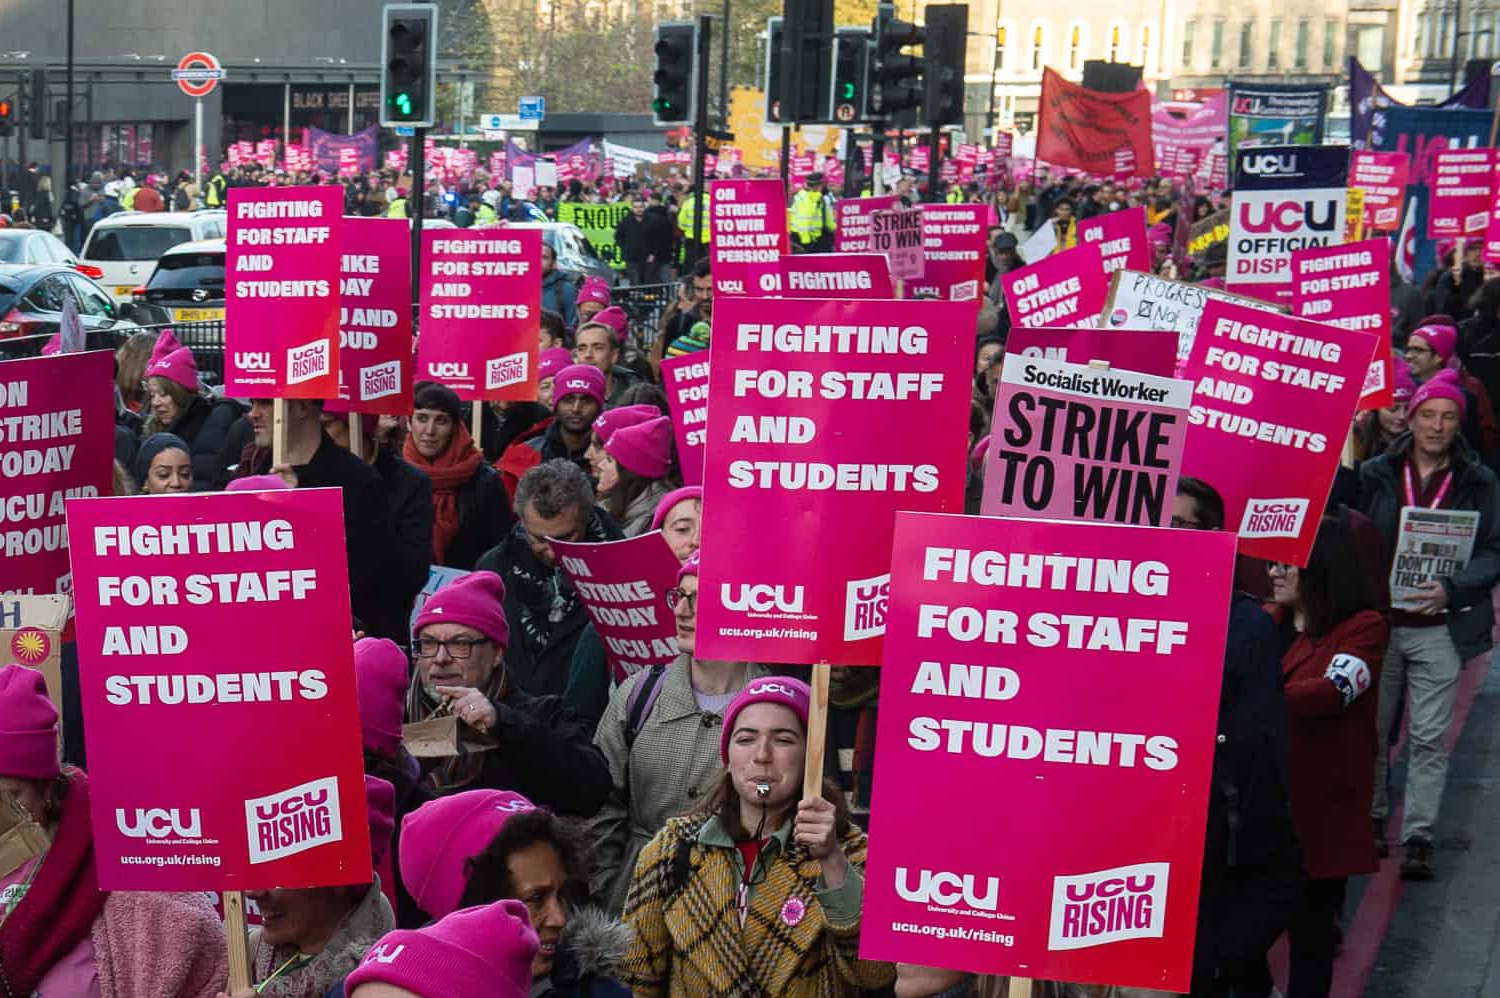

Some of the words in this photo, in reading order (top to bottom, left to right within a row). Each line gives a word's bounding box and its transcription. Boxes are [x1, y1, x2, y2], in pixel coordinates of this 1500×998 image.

[1242, 155, 1297, 174] UCU
[715, 188, 736, 201] ON
[237, 200, 323, 219] FIGHTING
[715, 203, 767, 217] STRIKE
[1239, 200, 1337, 233] UCU
[715, 219, 734, 232] TO
[735, 219, 765, 232] WIN
[873, 211, 921, 232] STRIKE
[236, 228, 273, 246] FOR
[273, 227, 330, 245] STAFF
[716, 234, 755, 248] BACK
[756, 234, 780, 246] MY
[873, 233, 892, 250] TO
[895, 230, 922, 248] WIN
[1084, 226, 1104, 243] ON
[432, 240, 522, 254] FIGHTING
[717, 249, 780, 263] PENSION
[235, 254, 273, 272] AND
[431, 261, 469, 276] FOR
[471, 261, 530, 276] STAFF
[1300, 251, 1373, 274] FIGHTING
[235, 280, 330, 298] STUDENTS
[430, 283, 472, 297] AND
[717, 280, 743, 292] UCU
[788, 271, 872, 290] FIGHTING
[1012, 273, 1039, 296] ON
[1301, 279, 1330, 295] FOR
[1330, 271, 1380, 291] STAFF
[1017, 276, 1082, 314] STRIKE
[352, 308, 398, 327] AND
[429, 304, 530, 319] STUDENTS
[1020, 296, 1079, 329] TODAY
[1301, 299, 1333, 316] AND
[736, 323, 929, 355] FIGHTING
[1213, 317, 1341, 364] FIGHTING
[234, 352, 270, 369] UCU
[292, 344, 325, 361] UCU
[292, 355, 325, 378] RISING
[364, 366, 396, 380] UCU
[428, 363, 468, 377] UCU
[491, 366, 523, 384] RISING
[1204, 346, 1258, 380] FOR
[1261, 360, 1345, 395] STAFF
[364, 377, 396, 396] RISING
[733, 369, 816, 399] FOR
[819, 371, 945, 401] STAFF
[1023, 364, 1103, 399] Socialist
[1101, 377, 1169, 403] Worker
[1195, 376, 1254, 406] AND
[730, 415, 817, 445] AND
[1003, 392, 1176, 468] STRIKE
[1188, 405, 1328, 455] STUDENTS
[727, 460, 940, 494] STUDENTS
[999, 451, 1055, 511] TO
[1073, 464, 1167, 527] WIN
[1252, 503, 1301, 516] UCU
[1247, 513, 1298, 534] RISING
[94, 520, 295, 556] FIGHTING
[562, 555, 592, 577] ON
[923, 547, 1171, 596] FIGHTING
[98, 575, 180, 607] FOR
[185, 569, 317, 604] STAFF
[575, 580, 656, 603] STRIKE
[721, 583, 805, 613] UCU
[588, 604, 659, 627] TODAY
[101, 625, 189, 657] AND
[719, 627, 818, 640] ucu.org.uk/rising
[917, 604, 1019, 645] FOR
[1026, 612, 1189, 656] STAFF
[606, 635, 649, 658] UCU
[105, 669, 329, 706] STUDENTS
[749, 683, 796, 699] UCU
[910, 661, 1021, 701] AND
[907, 717, 1179, 771] STUDENTS
[256, 788, 329, 821] UCU
[116, 808, 202, 838] UCU
[258, 804, 332, 853] RISING
[120, 854, 221, 867] ucu.org.uk/rising
[895, 867, 1000, 911] UCU
[1065, 874, 1156, 903] UCU
[1062, 893, 1153, 938] RISING
[892, 922, 1014, 947] ucu.org.uk/rising
